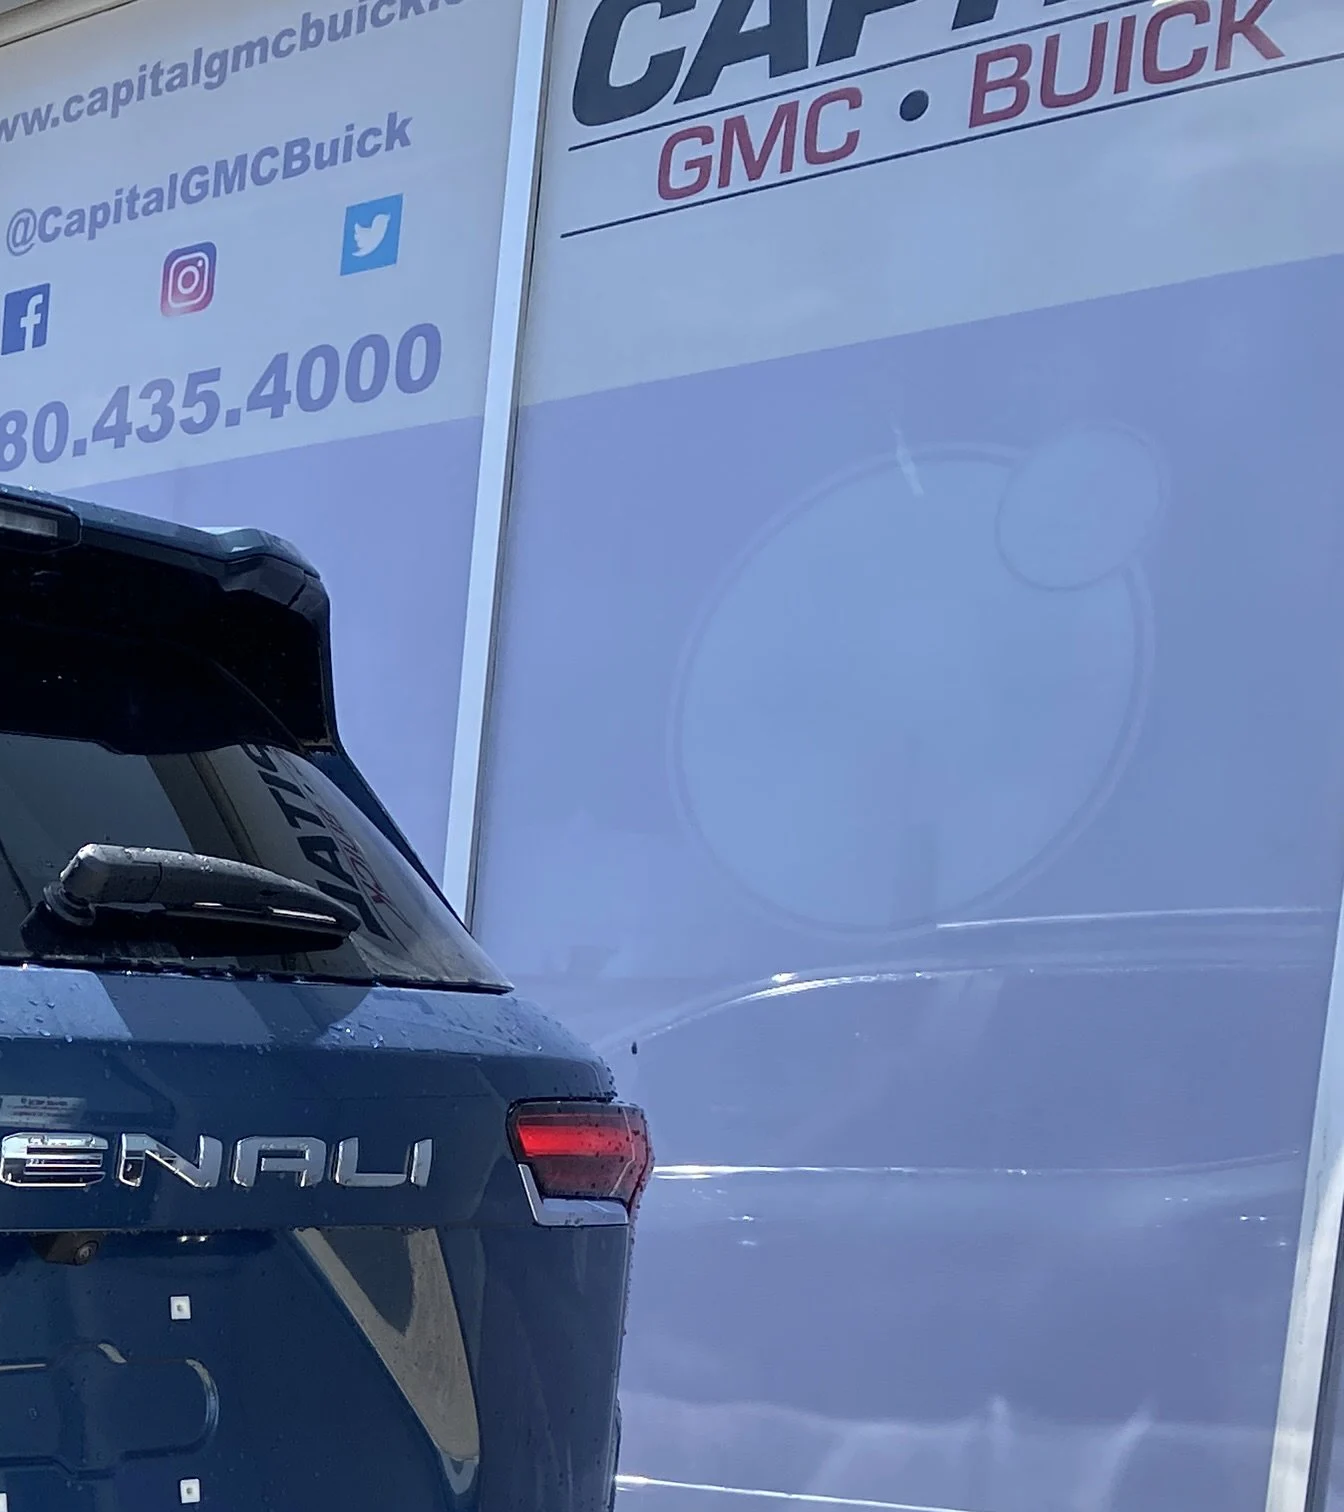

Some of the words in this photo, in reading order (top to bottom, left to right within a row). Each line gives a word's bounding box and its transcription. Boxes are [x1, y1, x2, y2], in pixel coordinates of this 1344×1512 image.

[6, 111, 413, 256] @CapitalGMCBuick
[657, 87, 863, 200] GMC
[969, 0, 1285, 128] BUICK
